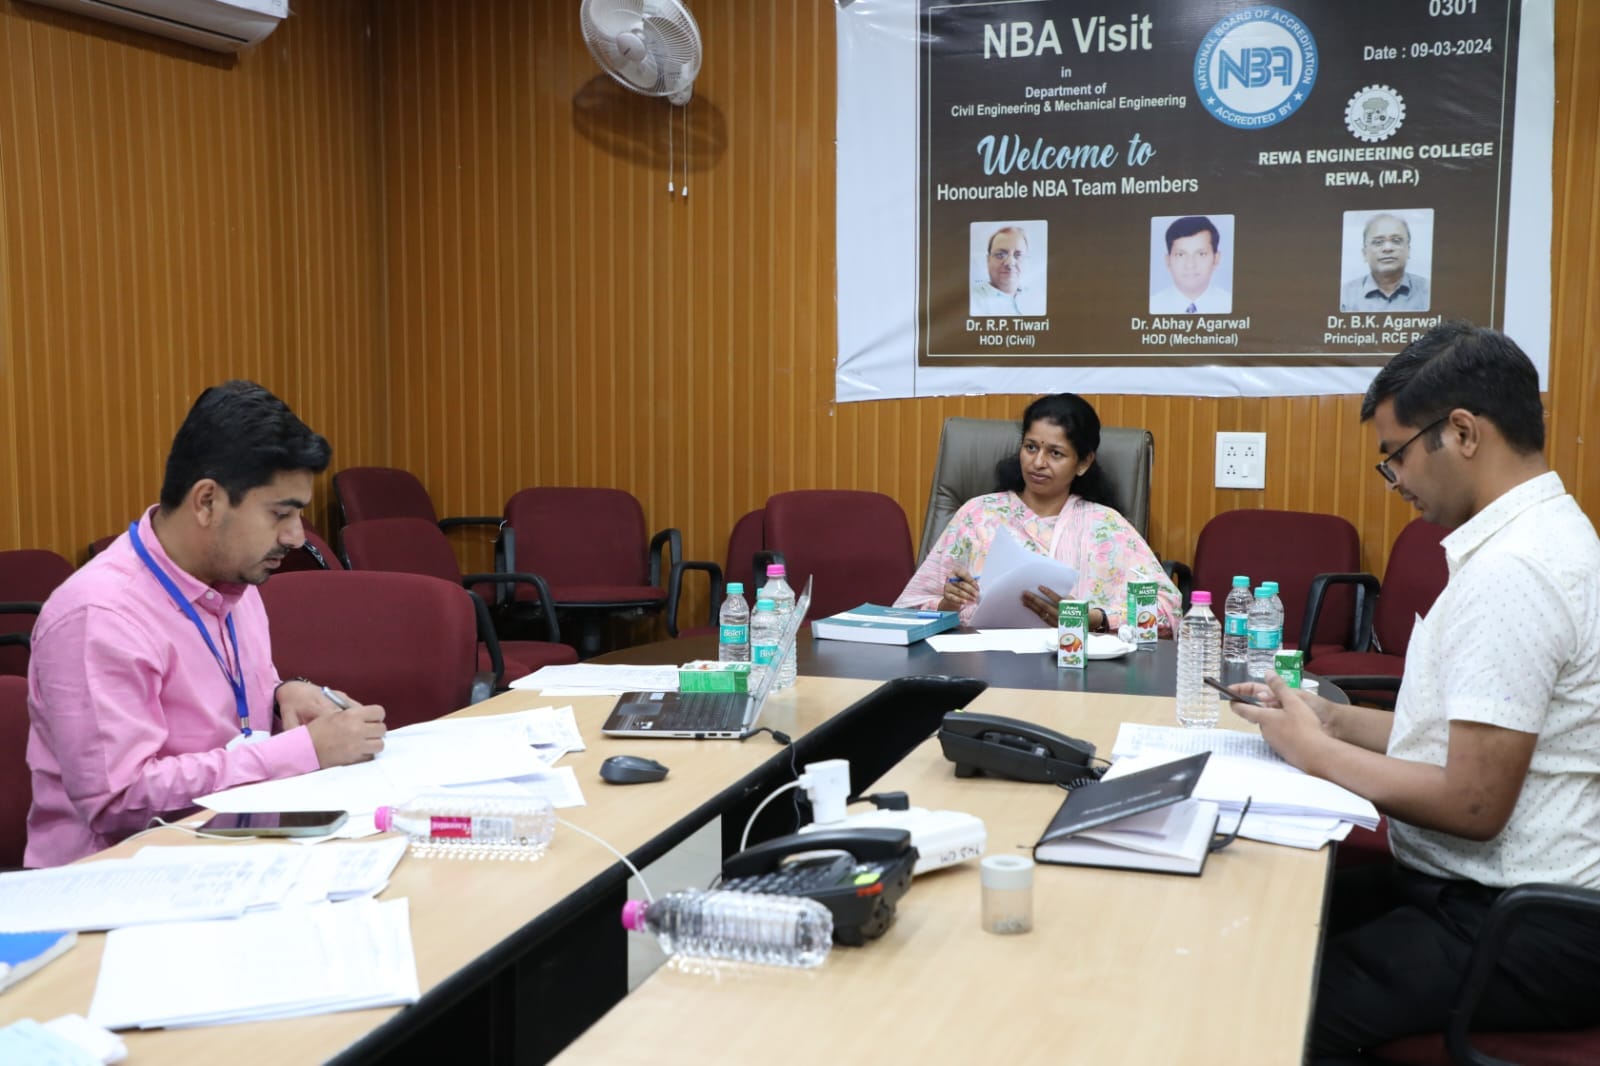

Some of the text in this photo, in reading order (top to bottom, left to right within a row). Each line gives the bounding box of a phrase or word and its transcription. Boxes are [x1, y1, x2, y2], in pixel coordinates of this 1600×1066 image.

[984, 14, 1153, 59] NBA Visit
[1198, 9, 1315, 90] NATIONAL BOARD OF ACCREDITATION
[1364, 45, 1397, 60] Date
[1410, 38, 1492, 58] 09-03-2024
[1060, 67, 1072, 78] in
[1219, 46, 1293, 89] NBA
[1025, 82, 1107, 100] Department of
[951, 94, 1186, 118] Civil Engineering & Mechanical Engineering
[1215, 102, 1293, 126] ACCREDITED BY
[977, 132, 1156, 176] Welcome to
[1258, 142, 1494, 166] REWA ENGINEERING COLLEGE
[937, 176, 1199, 201] Honourable NBA Team Members
[1325, 169, 1420, 188] REWA, (M.P.)
[966, 319, 1049, 331] Dr. R.P. Tiwari
[1131, 316, 1250, 332] Dr. Abhay Agarwal
[1327, 315, 1442, 331] Dr. B.K. Agarwal
[979, 335, 1035, 347] HOD (Civil)
[1142, 333, 1238, 347] HOD (Mechanical)
[1324, 332, 1378, 346] Principal,
[1381, 332, 1408, 343] RCE
